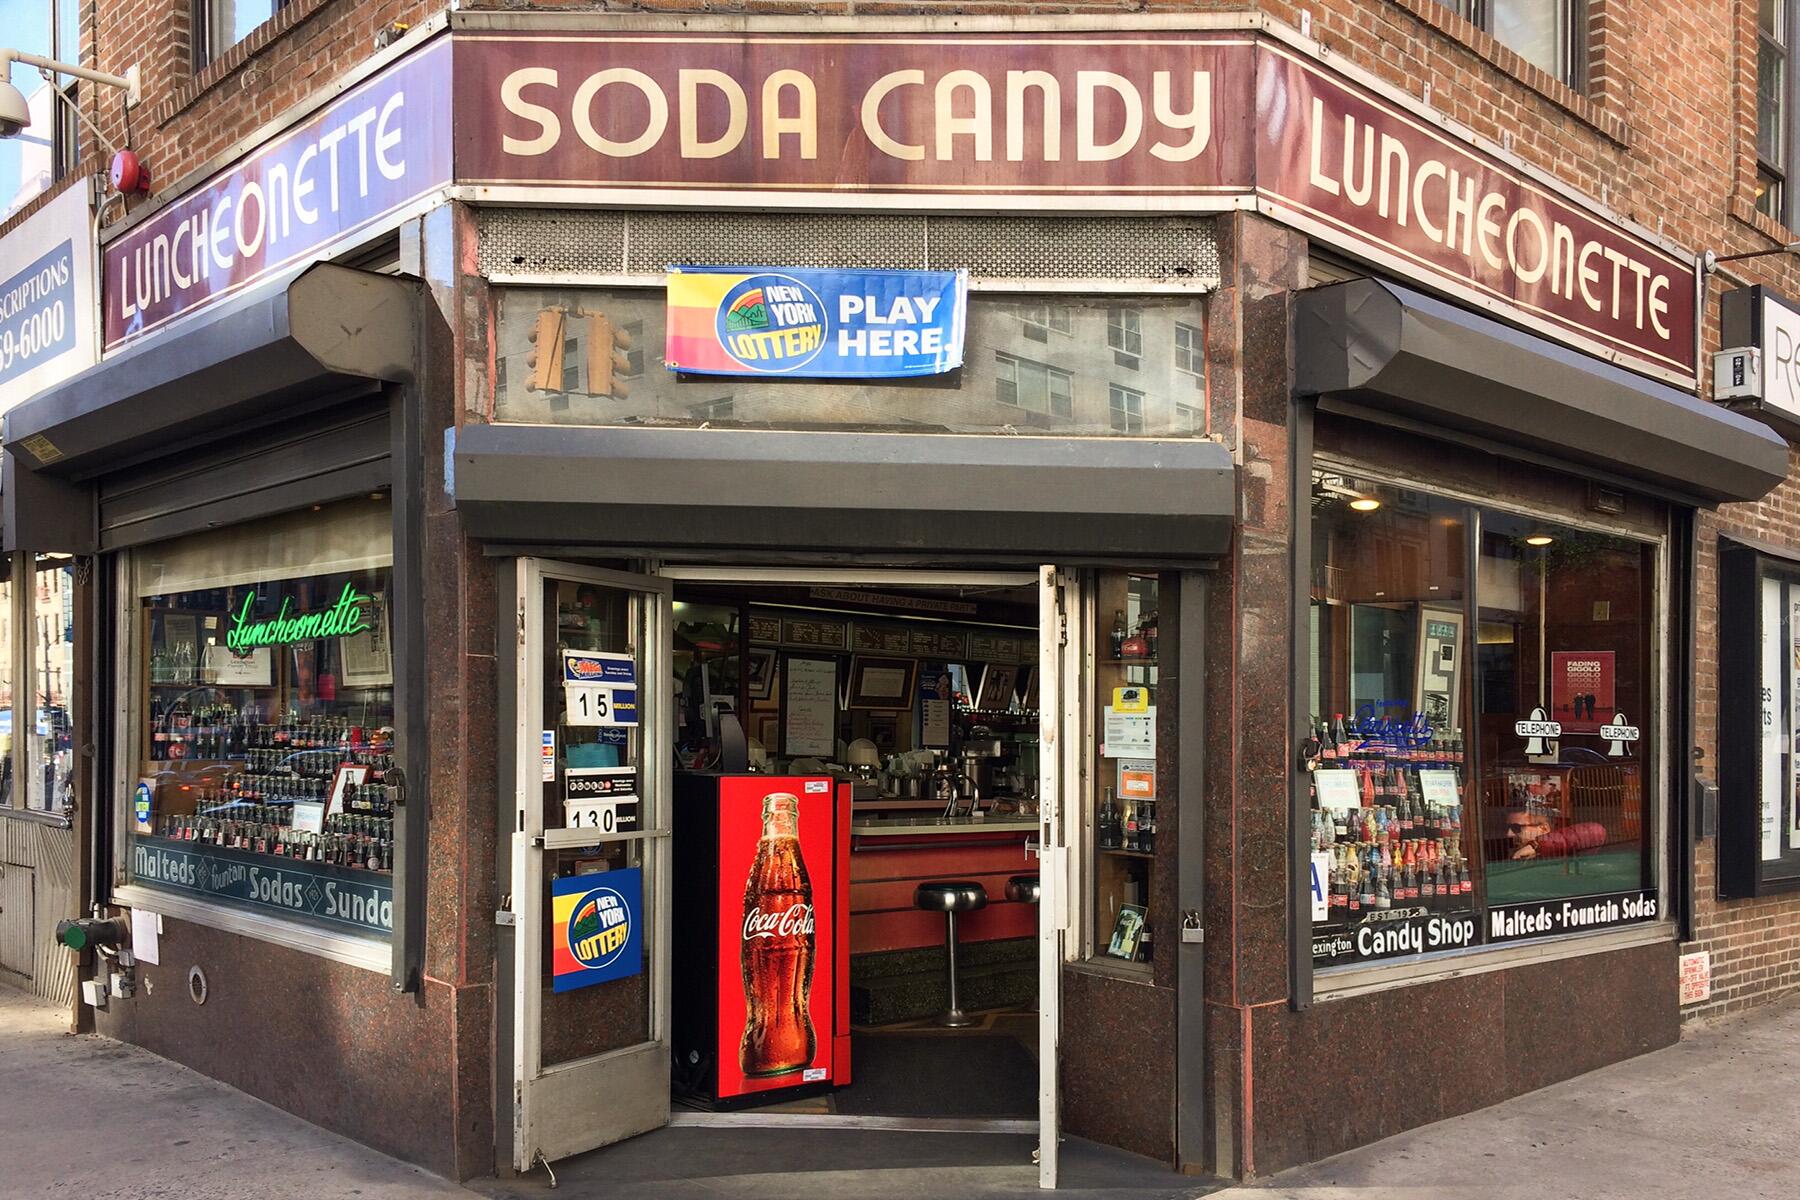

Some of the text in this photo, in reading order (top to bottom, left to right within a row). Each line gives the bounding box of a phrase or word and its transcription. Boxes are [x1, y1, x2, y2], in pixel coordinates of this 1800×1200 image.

[501, 66, 1212, 163] SODA CANDY
[120, 91, 406, 319] LUNCHEONETTE
[1310, 97, 1672, 341] LUNCHEONETTE
[766, 286, 804, 303] NEW
[839, 295, 941, 325] PLAY
[771, 302, 816, 327] YORK
[727, 324, 822, 361] LOTTERY
[227, 582, 373, 654] Luncheonette
[1517, 722, 1560, 735] TELEPHONE
[1601, 727, 1639, 739] TELEPHONE
[135, 846, 196, 885] Malteds
[249, 867, 302, 908] Sodas
[325, 881, 393, 928] Sunda
[596, 896, 619, 911] NEW
[600, 907, 625, 929] YORK
[743, 903, 815, 940] Coca-Cola
[1491, 893, 1656, 938] Malteds Fountain Sodas
[574, 922, 628, 960] LOTTERY
[1312, 918, 1475, 957] exington Candy Shop
